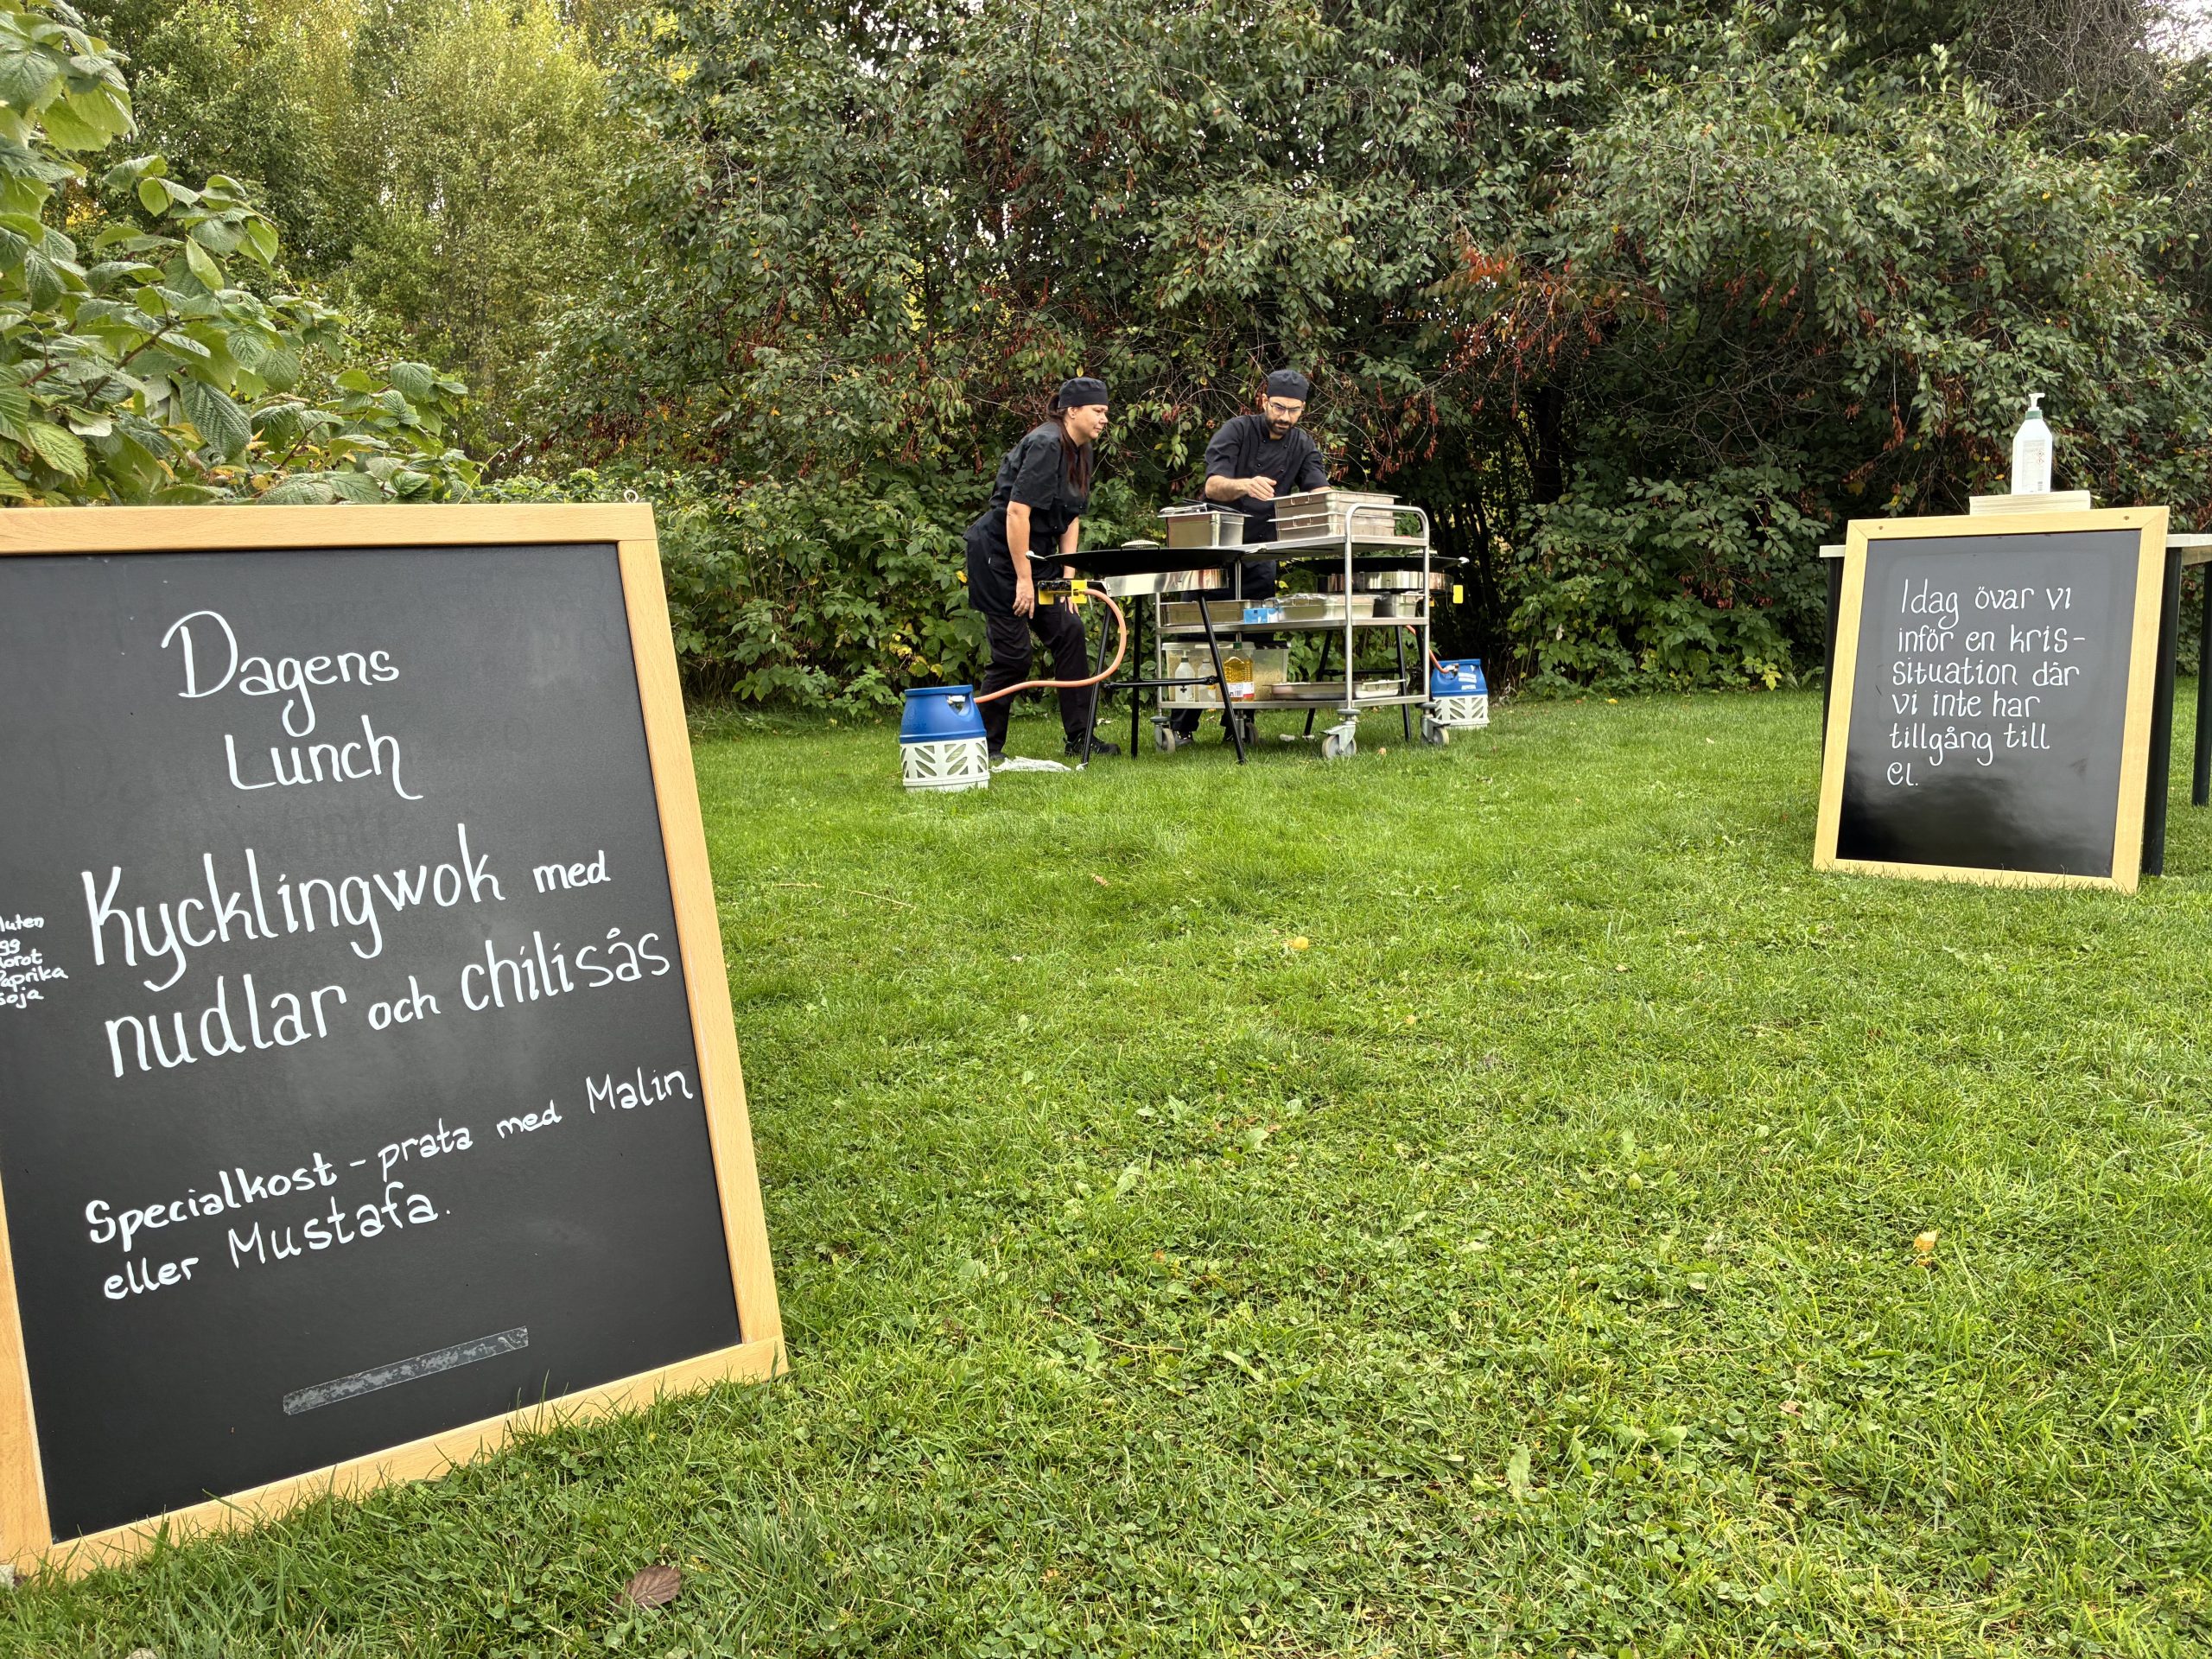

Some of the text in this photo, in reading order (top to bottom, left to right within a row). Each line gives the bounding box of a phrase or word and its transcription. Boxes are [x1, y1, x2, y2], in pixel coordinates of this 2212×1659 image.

[1901, 577, 2071, 630] Idag övar vi
[1897, 623, 2086, 653] inför en kris-
[160, 610, 400, 738] Dagens
[1892, 657, 2080, 687] situation där
[1891, 689, 2041, 718] vi inte har
[224, 714, 424, 801] Lunch
[1889, 721, 2050, 766] tillgång till
[0, 913, 45, 932] luten
[80, 822, 612, 993] Kycklingwok med
[104, 927, 671, 1078] nudlar och chilisås
[85, 1152, 338, 1254] Specialkost
[377, 1118, 474, 1183] prata
[496, 1098, 567, 1139] med
[585, 1066, 694, 1115] Malin
[104, 1256, 200, 1300] eller
